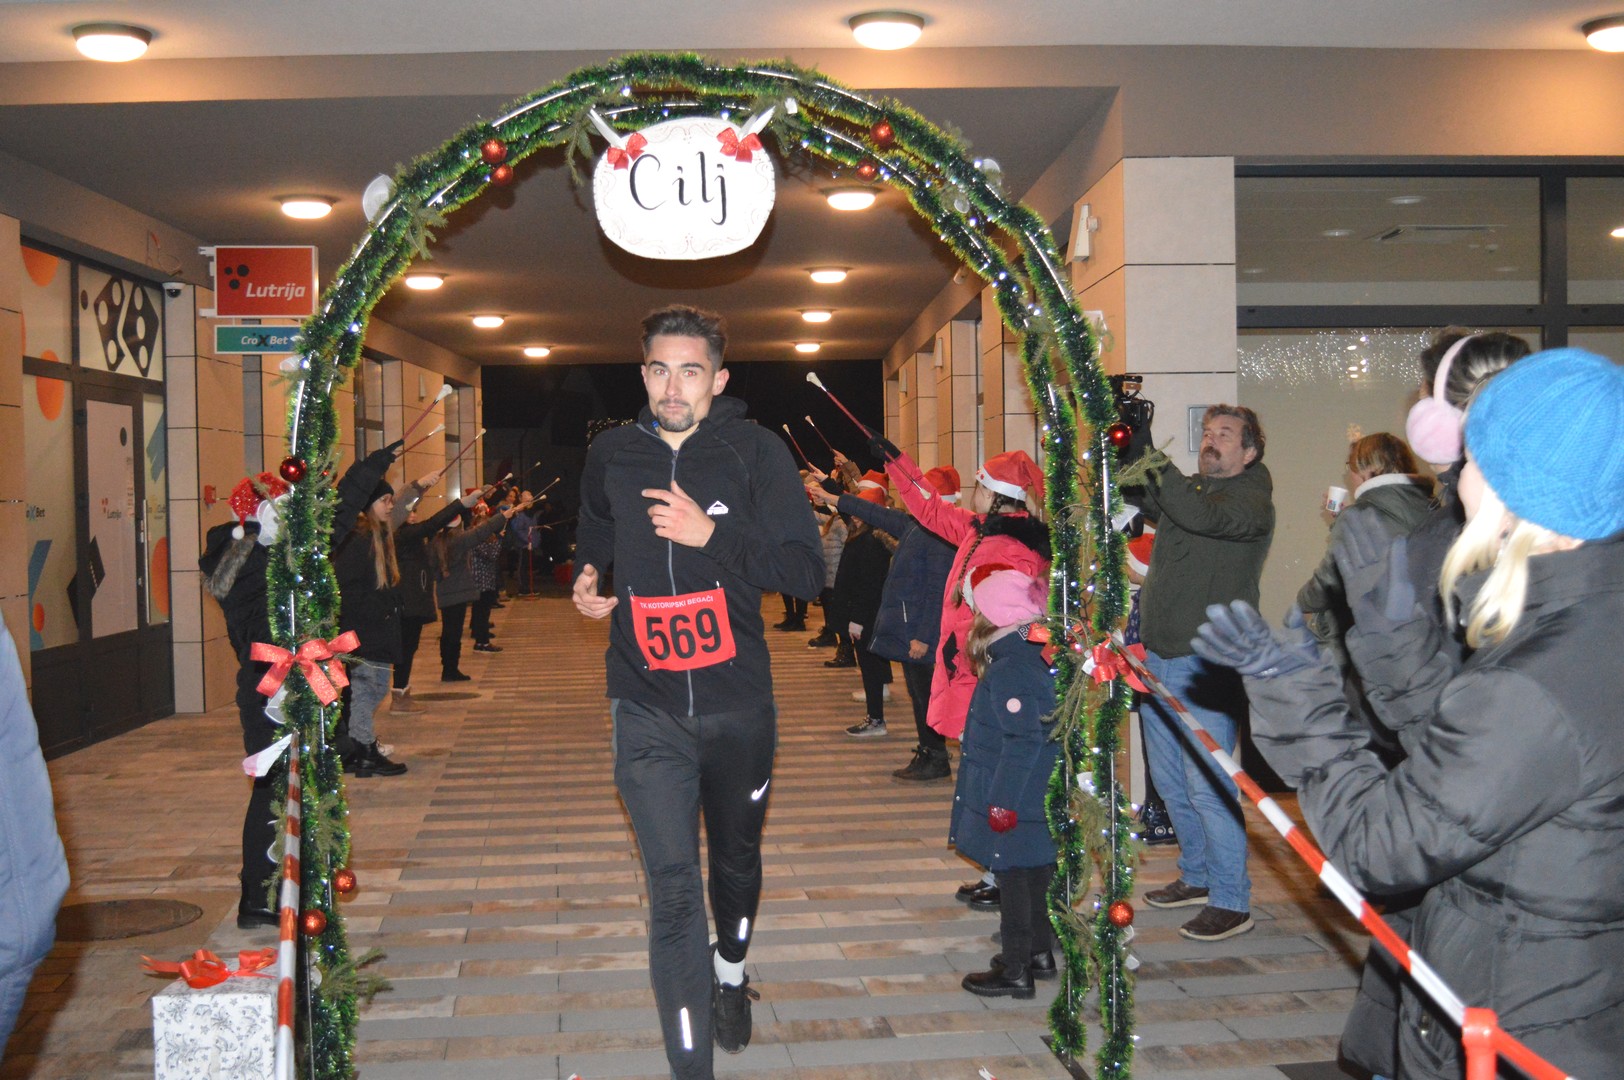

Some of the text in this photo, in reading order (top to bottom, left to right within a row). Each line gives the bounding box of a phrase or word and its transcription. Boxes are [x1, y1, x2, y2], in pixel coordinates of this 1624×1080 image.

[629, 151, 727, 225] Cilj
[246, 283, 306, 301] Lutrija
[648, 600, 687, 609] KOTORIPSKI
[687, 595, 714, 605] BEGAČI
[645, 608, 722, 660] 569
